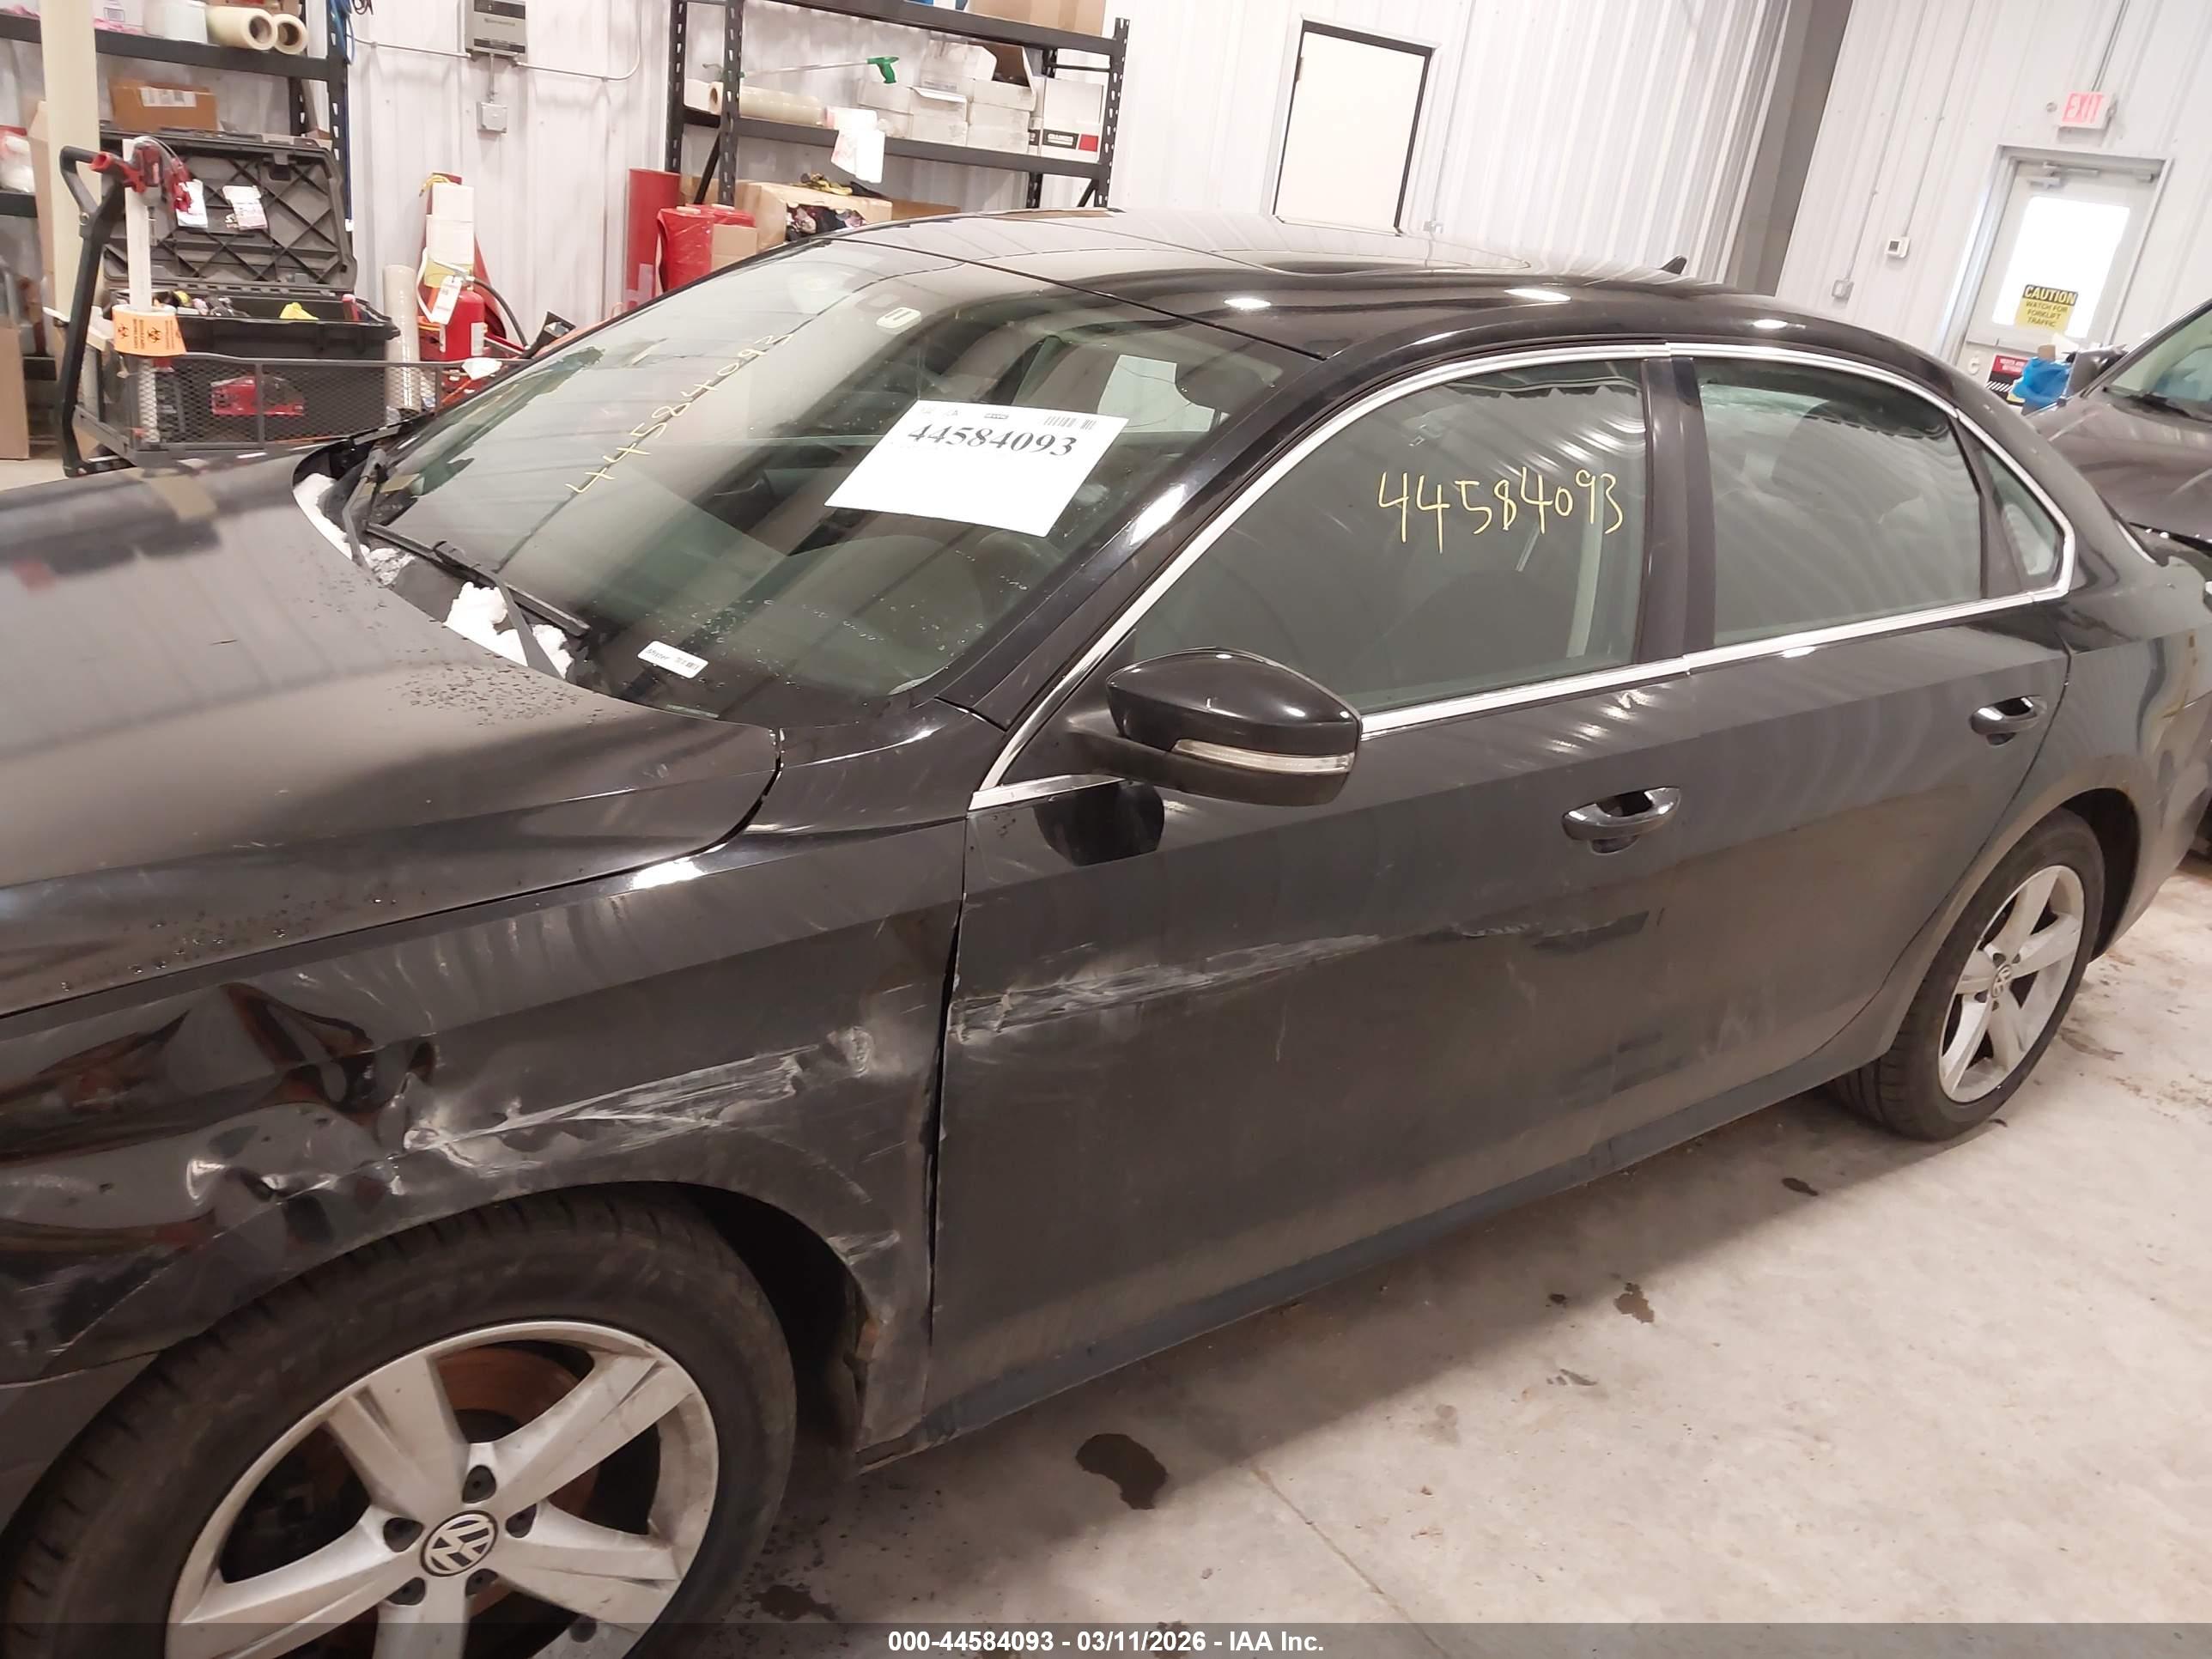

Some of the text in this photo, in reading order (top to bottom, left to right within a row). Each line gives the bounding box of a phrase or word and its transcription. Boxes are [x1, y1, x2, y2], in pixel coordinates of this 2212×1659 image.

[2063, 93, 2103, 124] EXIT
[2025, 286, 2076, 304] CAUTION
[2026, 301, 2051, 310] WATCH
[2027, 308, 2062, 319] FORKLIFT
[2027, 316, 2056, 327] TRAFFIC
[908, 423, 1077, 456] 44584093
[1377, 466, 1623, 554] 44584093
